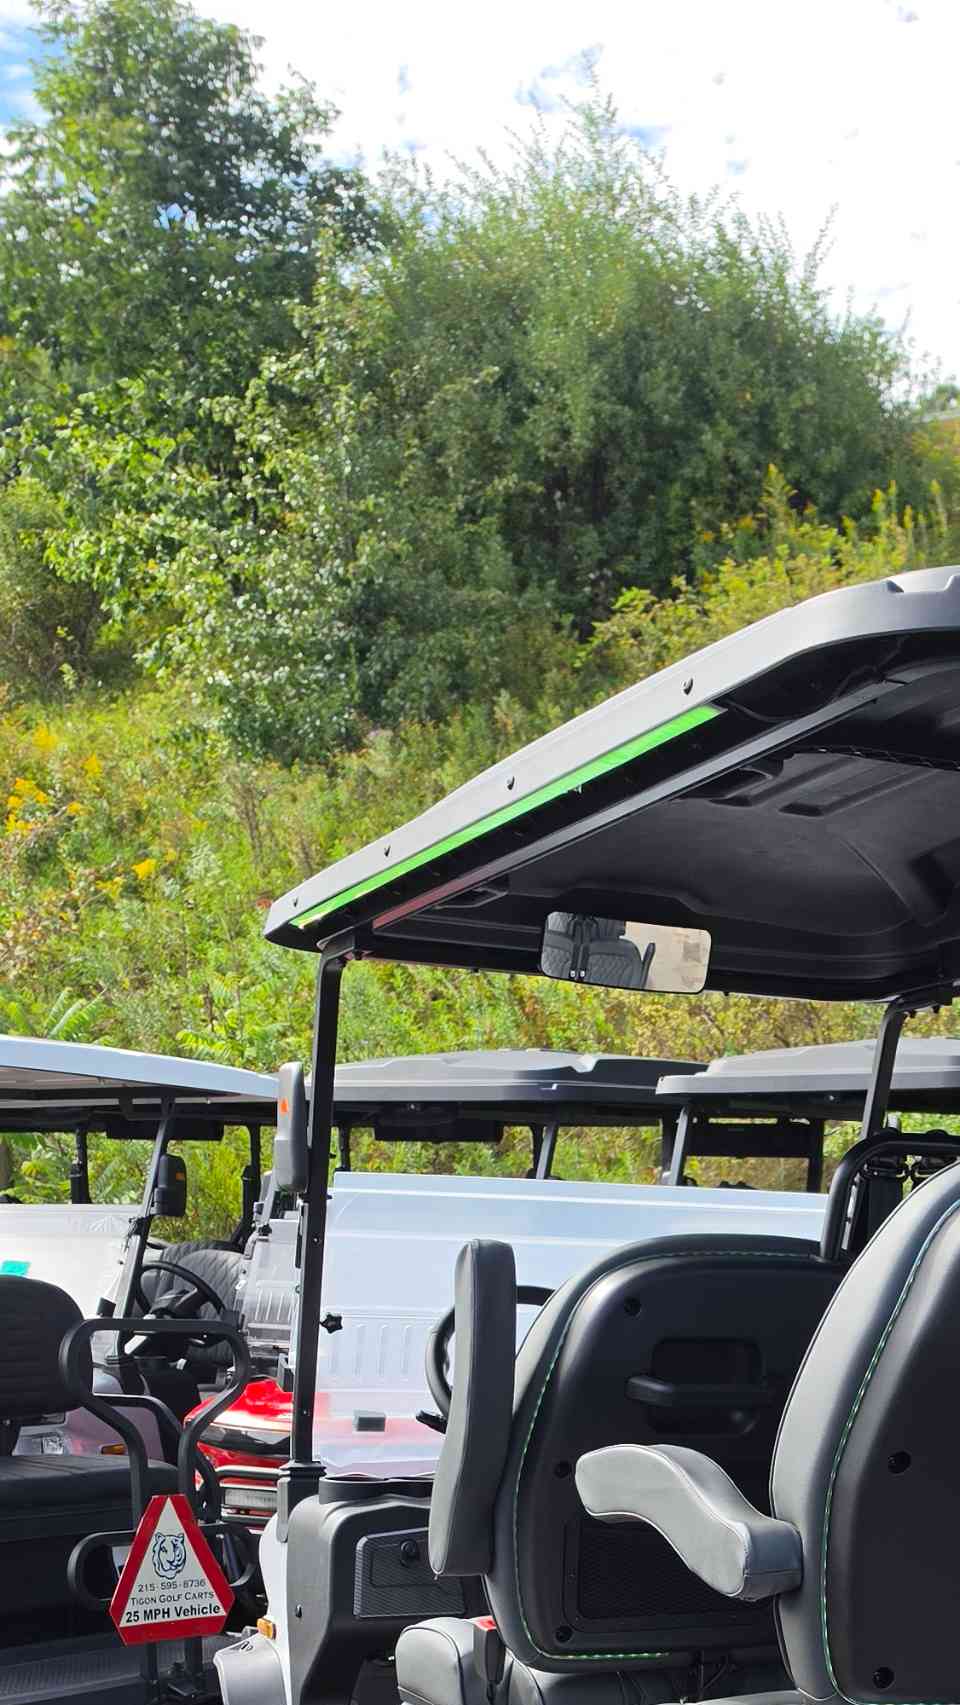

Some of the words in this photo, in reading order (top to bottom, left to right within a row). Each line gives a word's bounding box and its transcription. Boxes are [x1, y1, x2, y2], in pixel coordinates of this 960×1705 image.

[131, 1597, 156, 1606] TIGON
[159, 1594, 182, 1603] GOLF
[184, 1591, 214, 1601] CARTS
[126, 1610, 140, 1623] 25
[143, 1607, 170, 1621] MPH
[174, 1603, 220, 1617] Vehicle
